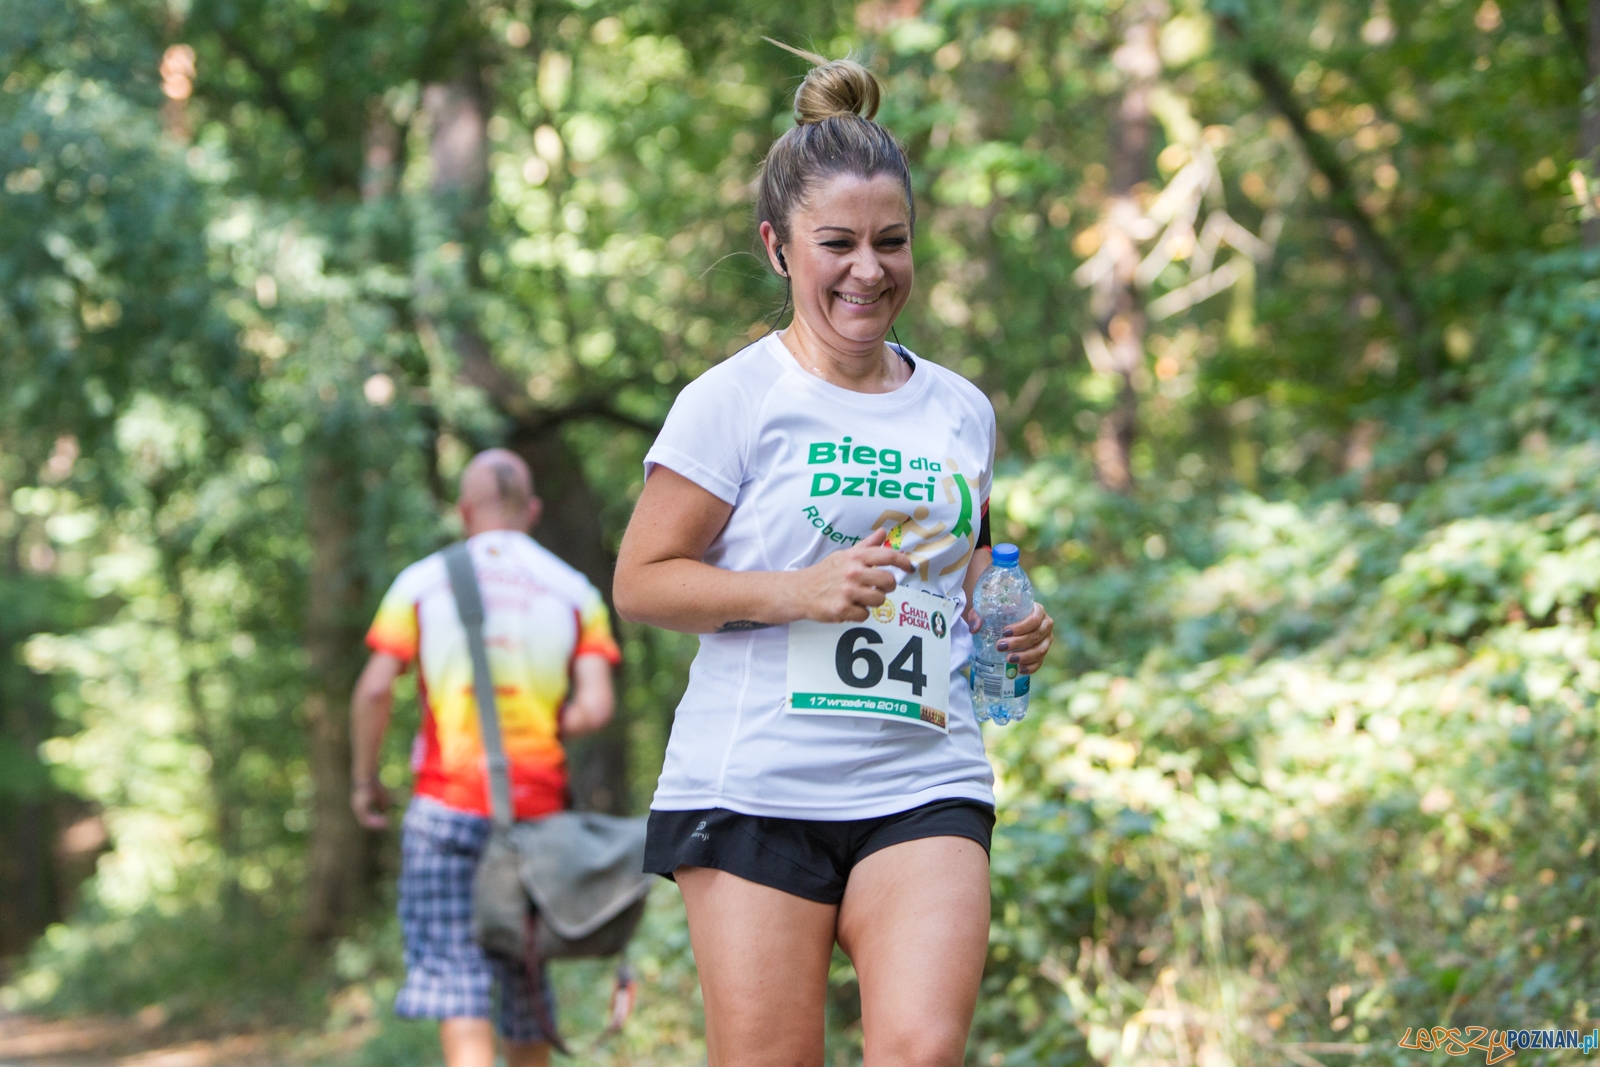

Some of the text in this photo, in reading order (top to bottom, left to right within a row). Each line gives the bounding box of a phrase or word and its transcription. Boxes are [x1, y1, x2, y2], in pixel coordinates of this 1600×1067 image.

[807, 436, 942, 474] Bieg dla
[810, 470, 936, 502] Dzieci
[898, 613, 931, 632] POLSKA
[901, 601, 929, 621] CHATA
[835, 627, 928, 697] 64
[809, 696, 908, 713] 17 września 2016
